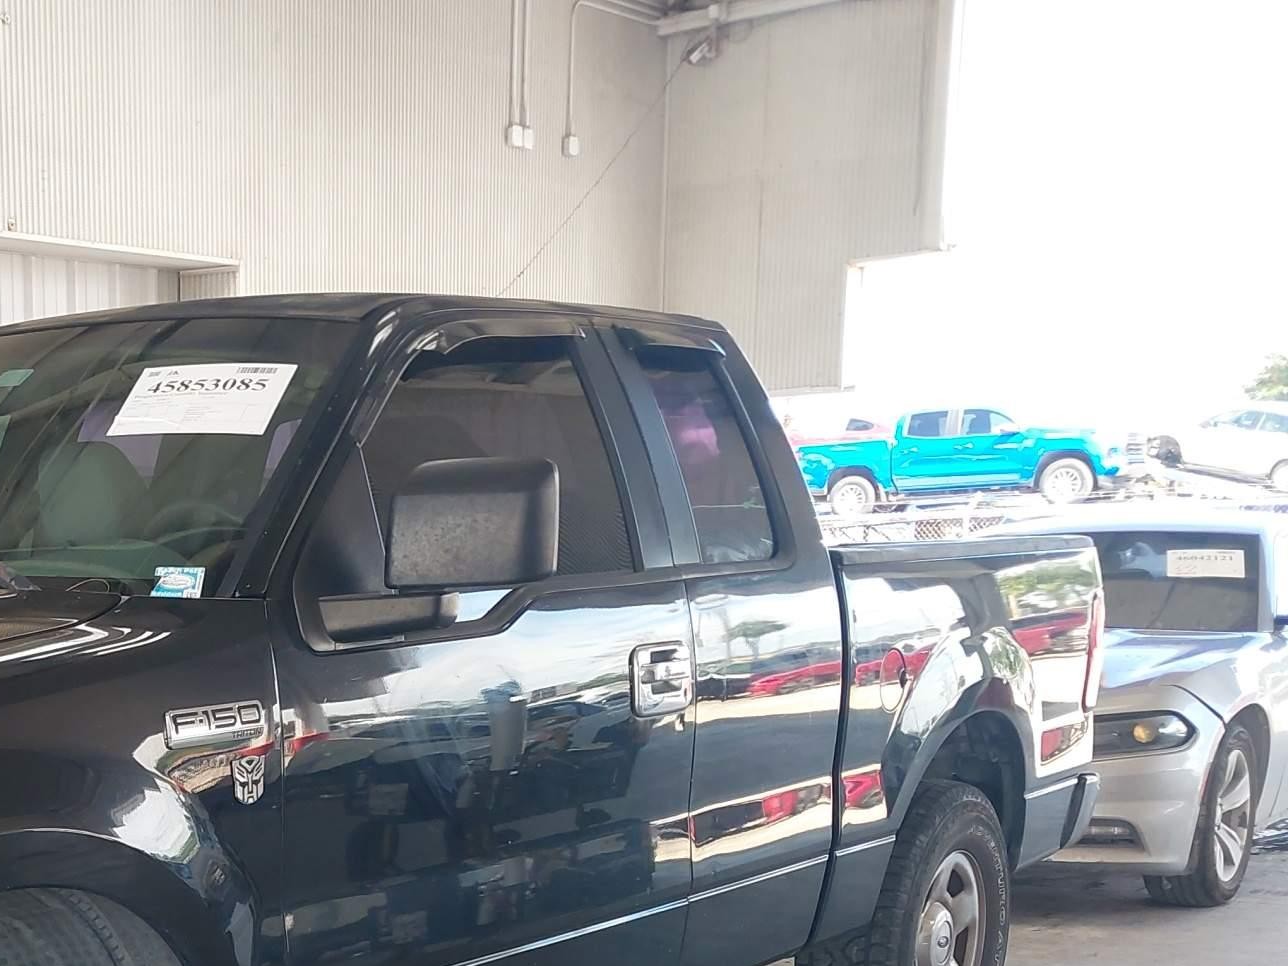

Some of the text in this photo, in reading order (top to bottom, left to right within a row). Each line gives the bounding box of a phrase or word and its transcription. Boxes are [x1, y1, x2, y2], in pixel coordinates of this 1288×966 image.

[147, 378, 270, 394] 45853085
[171, 703, 262, 735] F-150
[231, 727, 264, 739] TRITON
